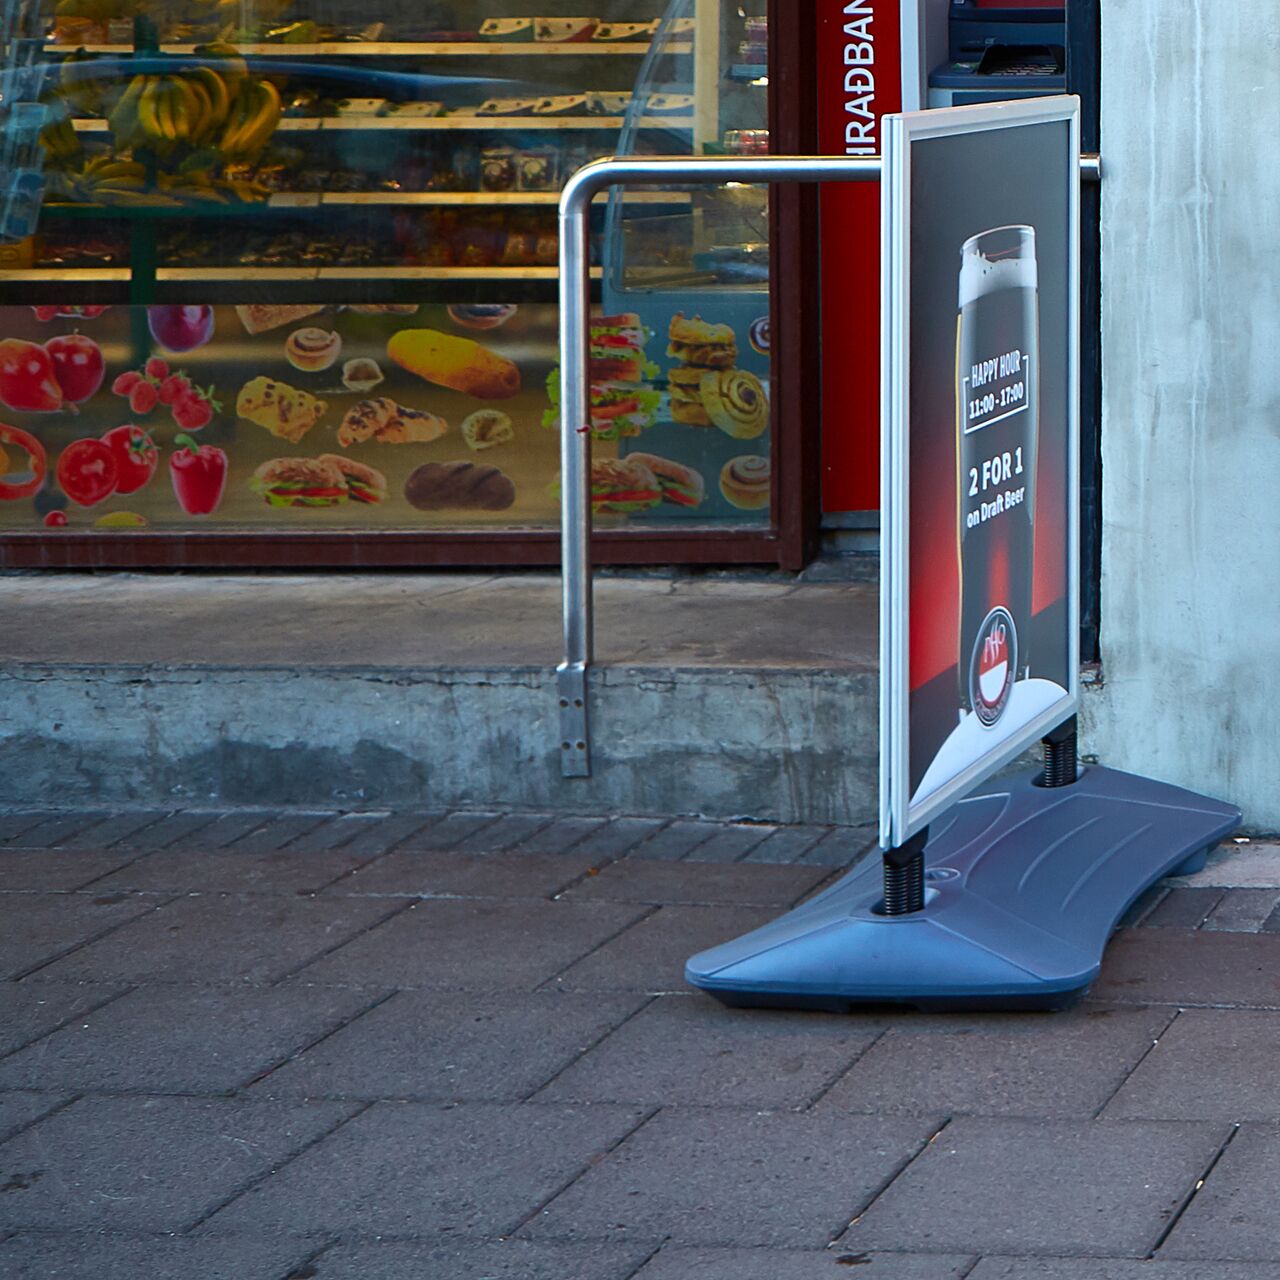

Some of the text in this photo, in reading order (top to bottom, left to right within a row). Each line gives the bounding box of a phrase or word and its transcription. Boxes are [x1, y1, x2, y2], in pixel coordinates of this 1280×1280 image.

[971, 350, 1021, 389] HAPPY HOUR
[969, 393, 995, 420] 11:00
[1000, 381, 1024, 407] 17:00
[968, 446, 1024, 497] 2 FOR 1
[967, 486, 1025, 528] on Draft Beer
